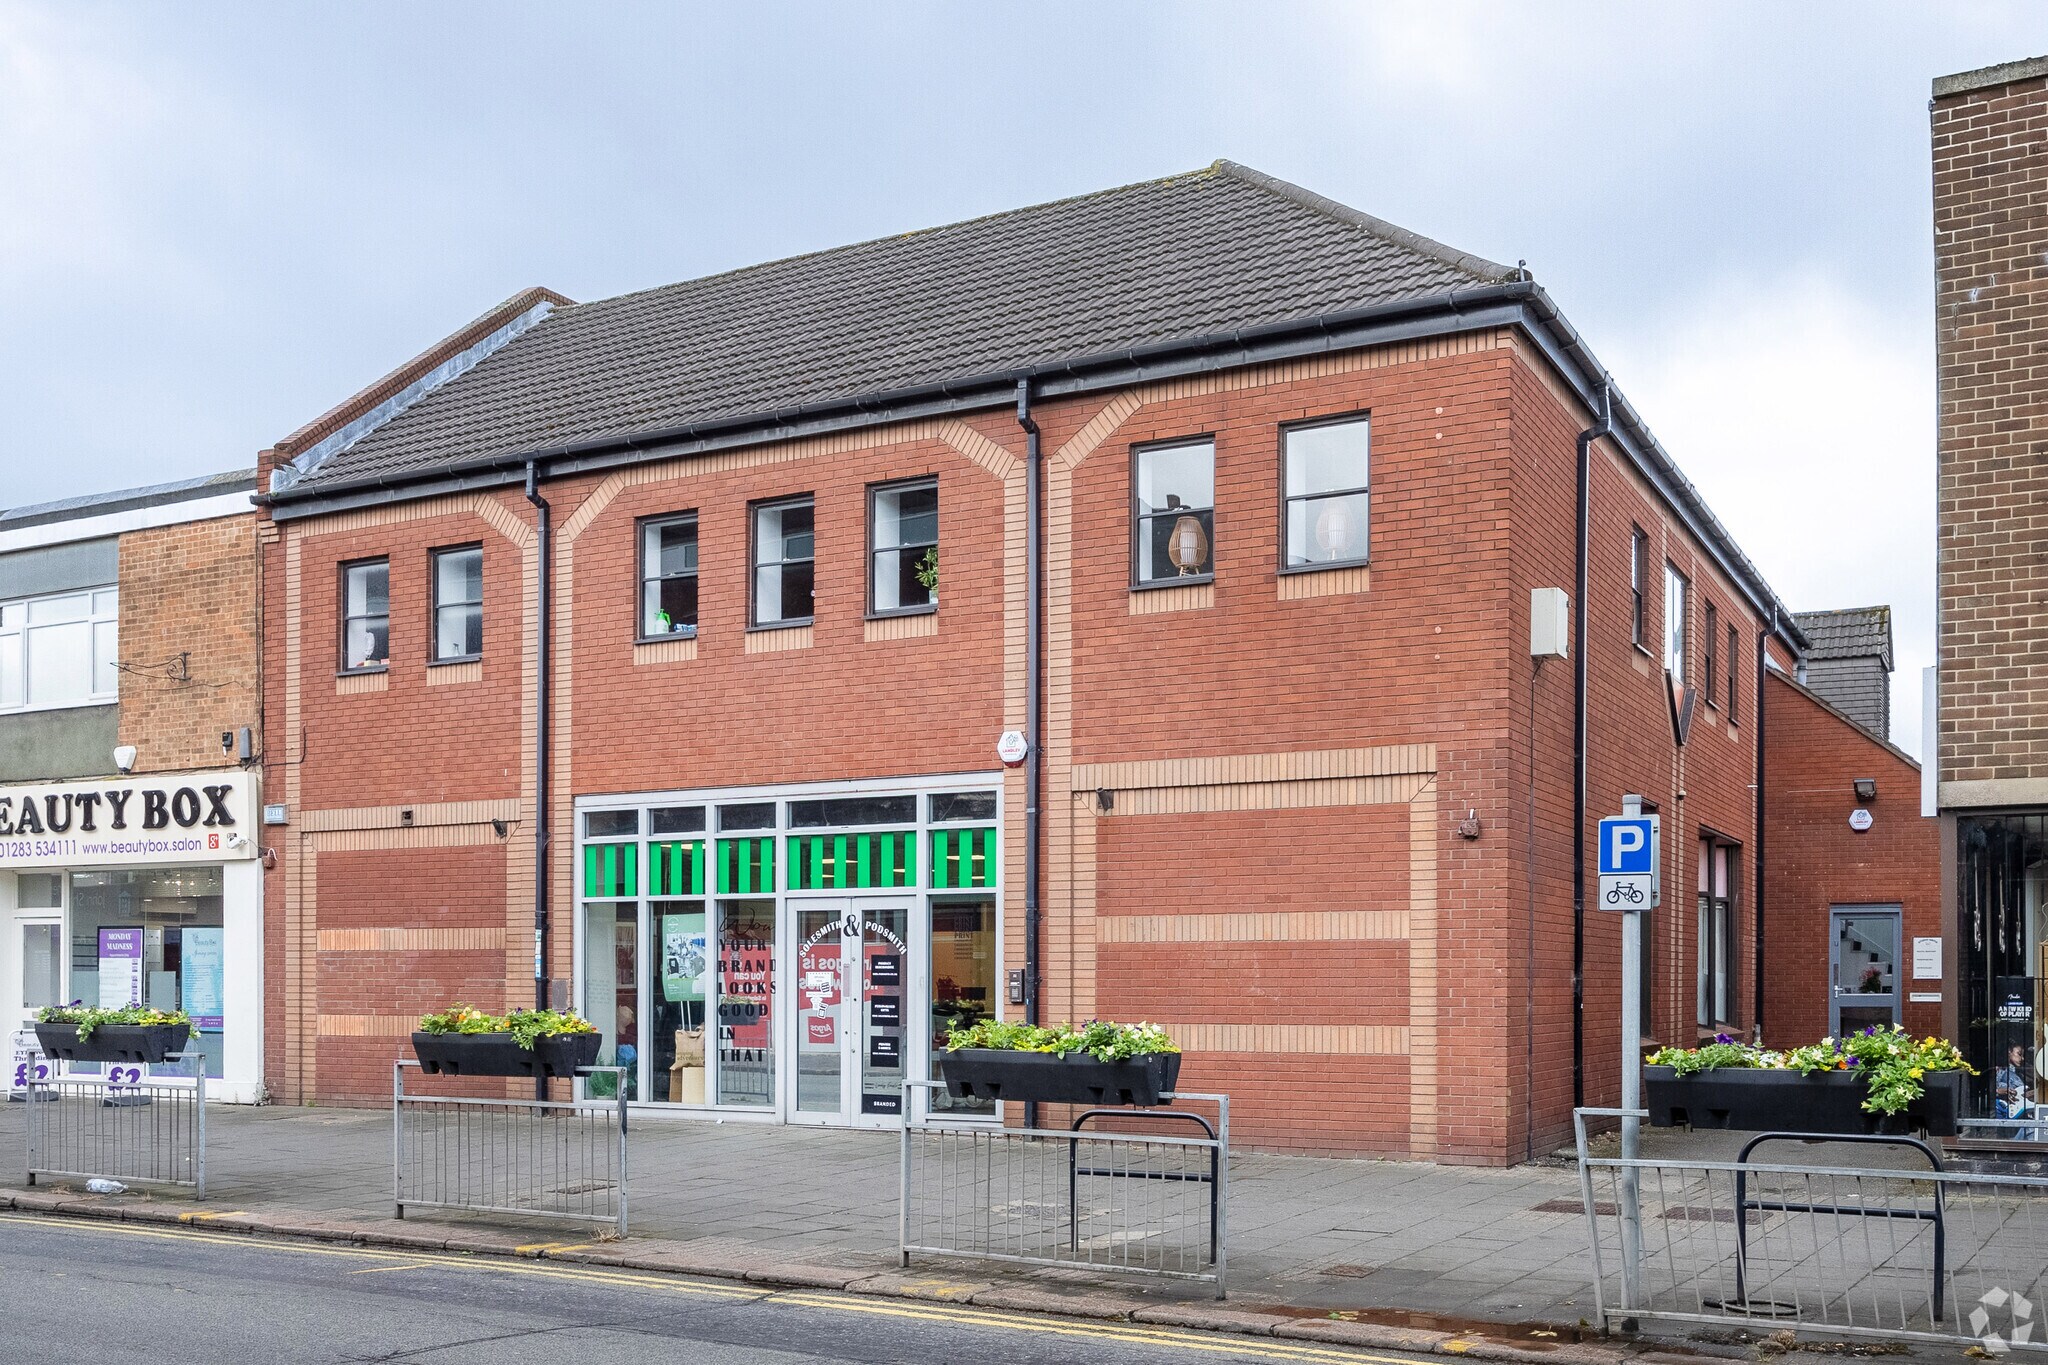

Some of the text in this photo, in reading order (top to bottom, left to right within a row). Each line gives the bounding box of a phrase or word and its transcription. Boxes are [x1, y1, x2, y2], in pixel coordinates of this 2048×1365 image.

[142, 784, 235, 829] BOX
[36, 840, 77, 856] 534111
[82, 838, 202, 856] www.beautybox.salon
[1612, 825, 1644, 869] P
[800, 914, 907, 958] SOLESMITH & PODSMITH
[719, 939, 766, 951] YOUR
[718, 959, 776, 973] BRAND
[718, 981, 776, 994] LOOKS
[718, 1003, 768, 1016] GOOD
[719, 1027, 735, 1039] IN
[719, 1049, 767, 1061] THAT
[15, 1063, 49, 1087] £2
[108, 1066, 141, 1091] £2
